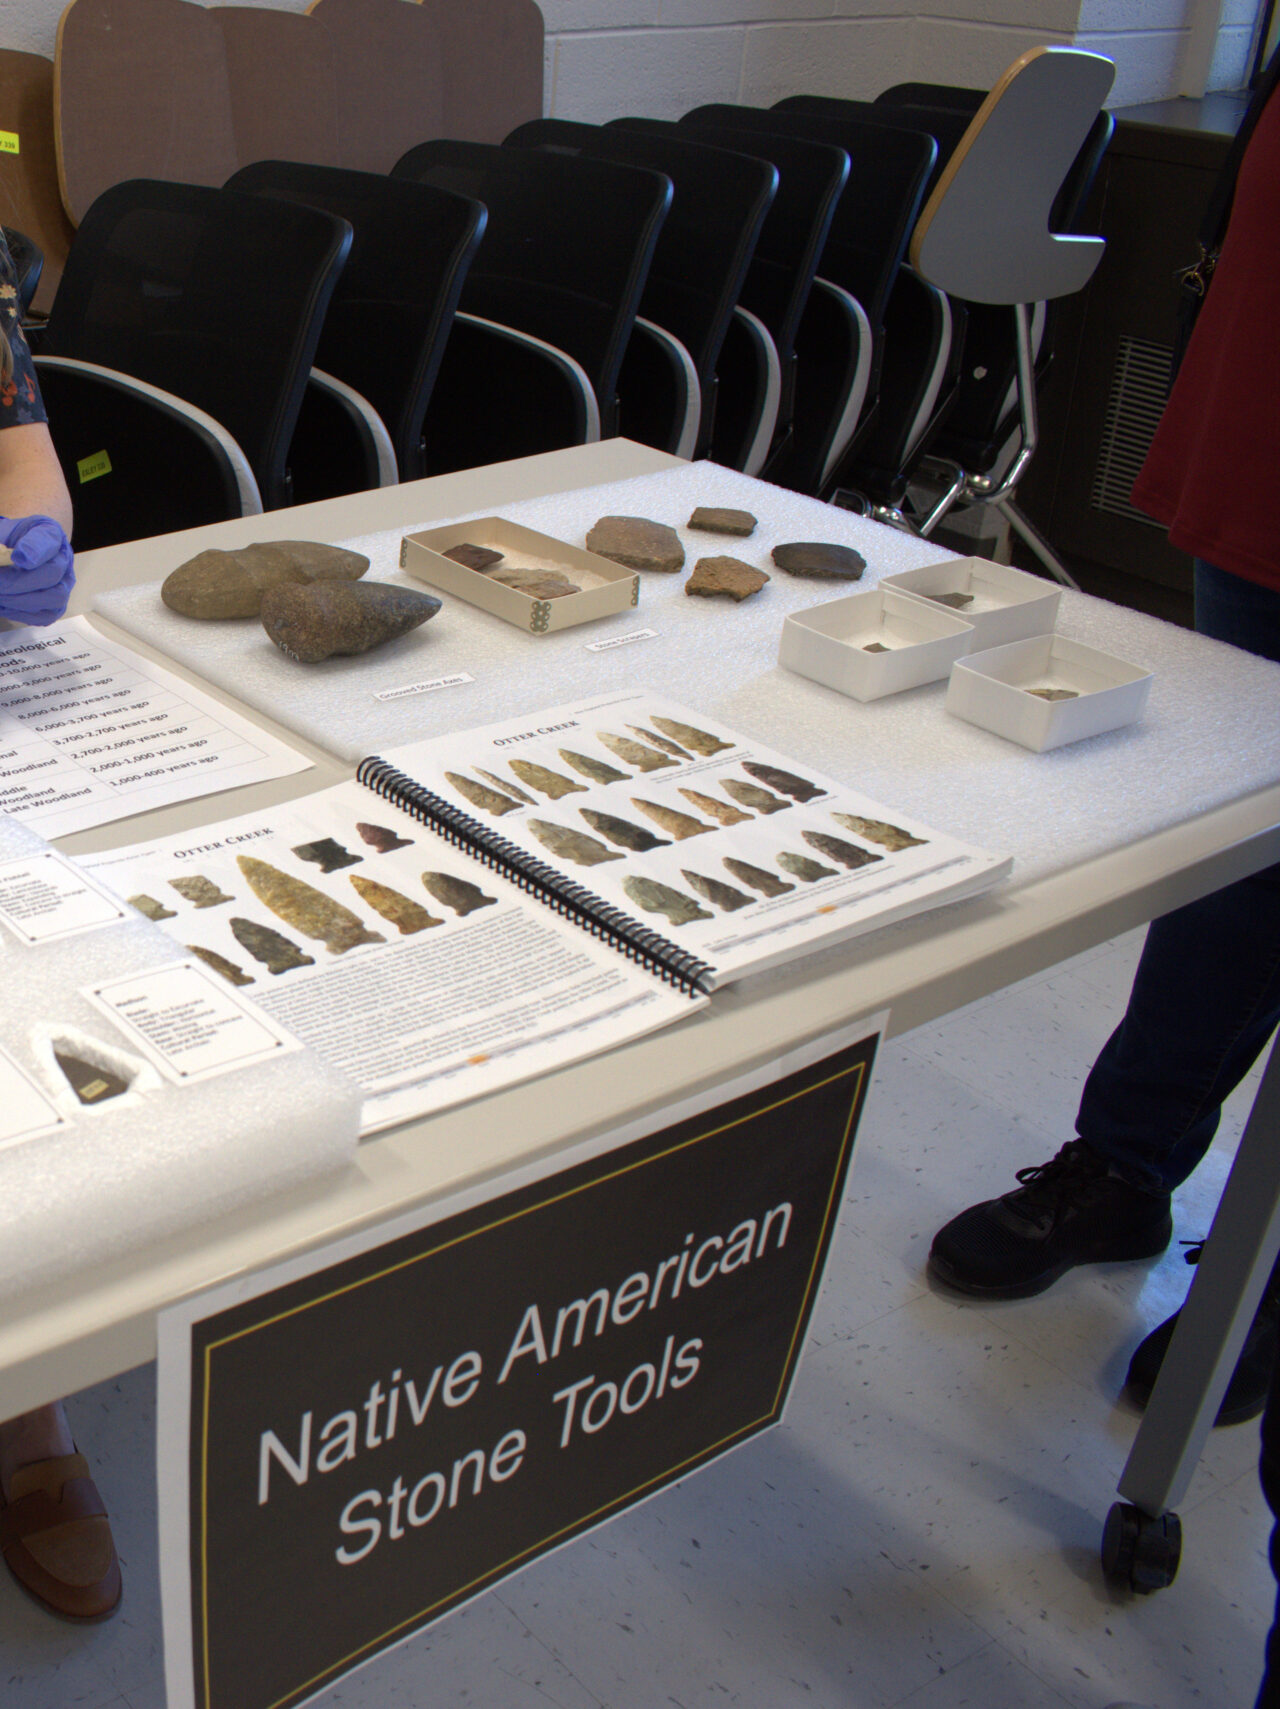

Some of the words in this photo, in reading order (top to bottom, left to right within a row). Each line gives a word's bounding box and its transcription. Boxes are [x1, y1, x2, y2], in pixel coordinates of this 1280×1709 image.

[43, 656, 71, 669] years
[72, 651, 91, 661] ago
[53, 668, 81, 681] years
[83, 664, 102, 673] ago
[1, 689, 63, 708] 9,000-8,000
[65, 681, 92, 694] years
[94, 677, 113, 687] ago
[18, 701, 81, 720] 8,000-6,000
[83, 693, 110, 706] years
[112, 689, 131, 699] ago
[35, 713, 99, 733] 6,000-3,700
[100, 705, 128, 718] years
[130, 700, 149, 710] ago
[53, 726, 117, 746] 3,700-2,700
[119, 718, 145, 730] years
[147, 713, 169, 723] ago
[71, 739, 136, 760] 2,700-2,000
[137, 730, 167, 743] years
[168, 725, 188, 736] ago
[493, 732, 537, 747] OTTER
[537, 720, 580, 735] CREEK
[90, 752, 155, 774] 2,000-1,000
[157, 744, 187, 757] years
[188, 738, 208, 749] ago
[110, 768, 166, 787] 1,000-400
[167, 760, 197, 773] years
[198, 755, 219, 766] ago
[3, 804, 30, 815] Late
[31, 787, 92, 808] Woodland
[173, 842, 224, 859] OTTER
[225, 827, 275, 845] CREEK
[258, 1350, 483, 1505] Native
[497, 1202, 793, 1386] American
[334, 1429, 526, 1565] Stone
[552, 1336, 703, 1448] Tools
